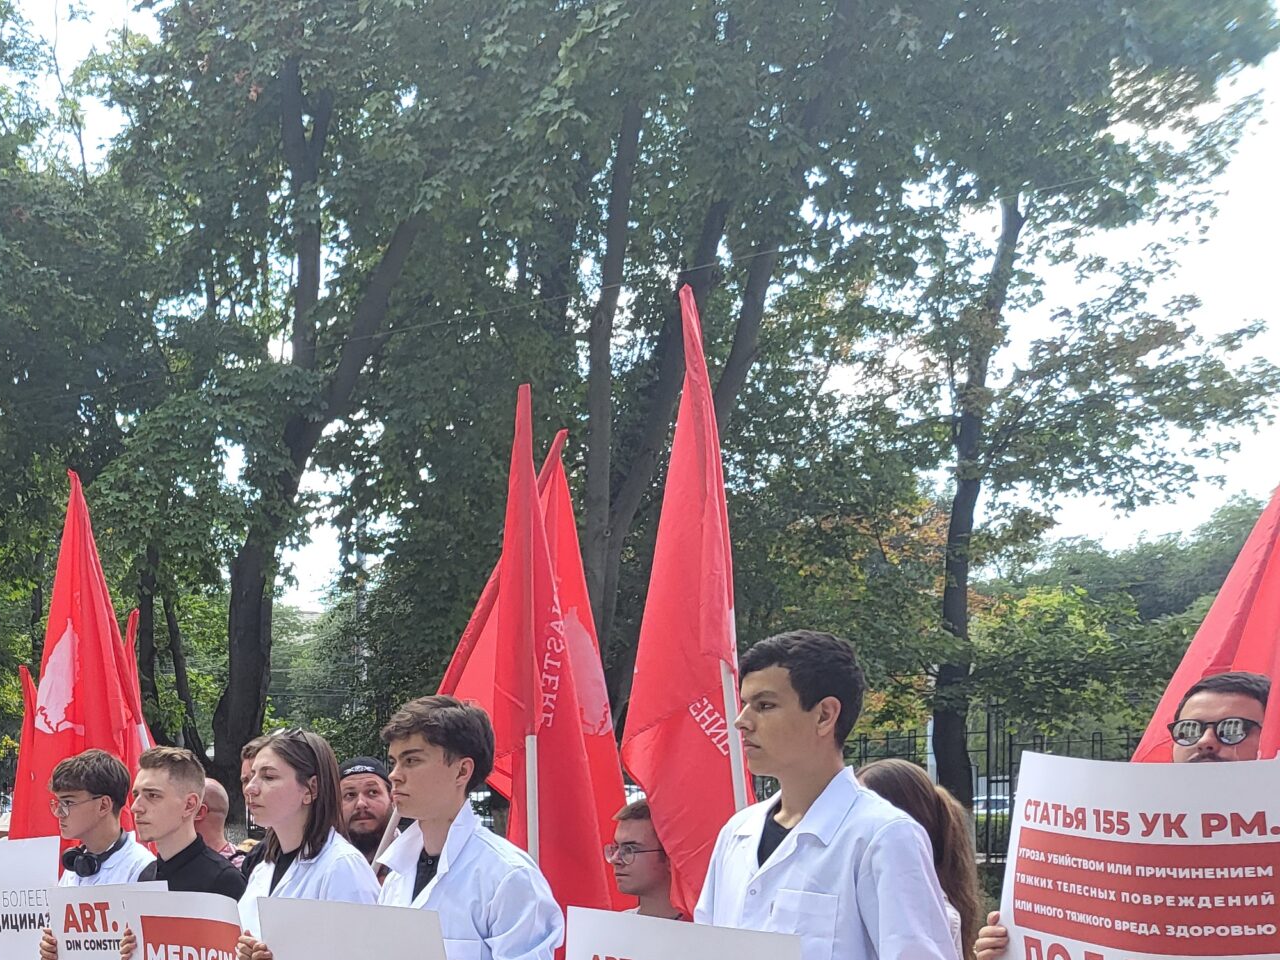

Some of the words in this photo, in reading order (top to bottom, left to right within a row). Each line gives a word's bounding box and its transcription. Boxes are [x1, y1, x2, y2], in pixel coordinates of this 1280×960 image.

[1023, 798, 1087, 831] СТАТЬЯ
[1092, 808, 1130, 836] 155
[1138, 811, 1188, 839] УК
[1201, 811, 1280, 838] РМ.
[1018, 847, 1045, 863] УГРОЗА
[1047, 851, 1105, 873] УБИЙСТВОМ
[1107, 863, 1132, 876] ИЛИ
[1135, 865, 1274, 879] ПРИЧИНЕНИЕМ
[1016, 872, 1054, 890] ТЯЖКИХ
[1056, 880, 1117, 901] ТЕЛЕСНЫХ
[1121, 890, 1275, 909] ПОВРЕЖДЕНИЙ
[63, 902, 119, 933] ART.
[1015, 899, 1033, 913] ИЛИ
[1033, 903, 1064, 919] ИНОГО
[1065, 909, 1112, 929] ТЯЖКОГО
[1114, 919, 1161, 936] ВРЕДА
[1165, 923, 1277, 938] ЗДОРОВЬЮ
[65, 939, 82, 951] DIN
